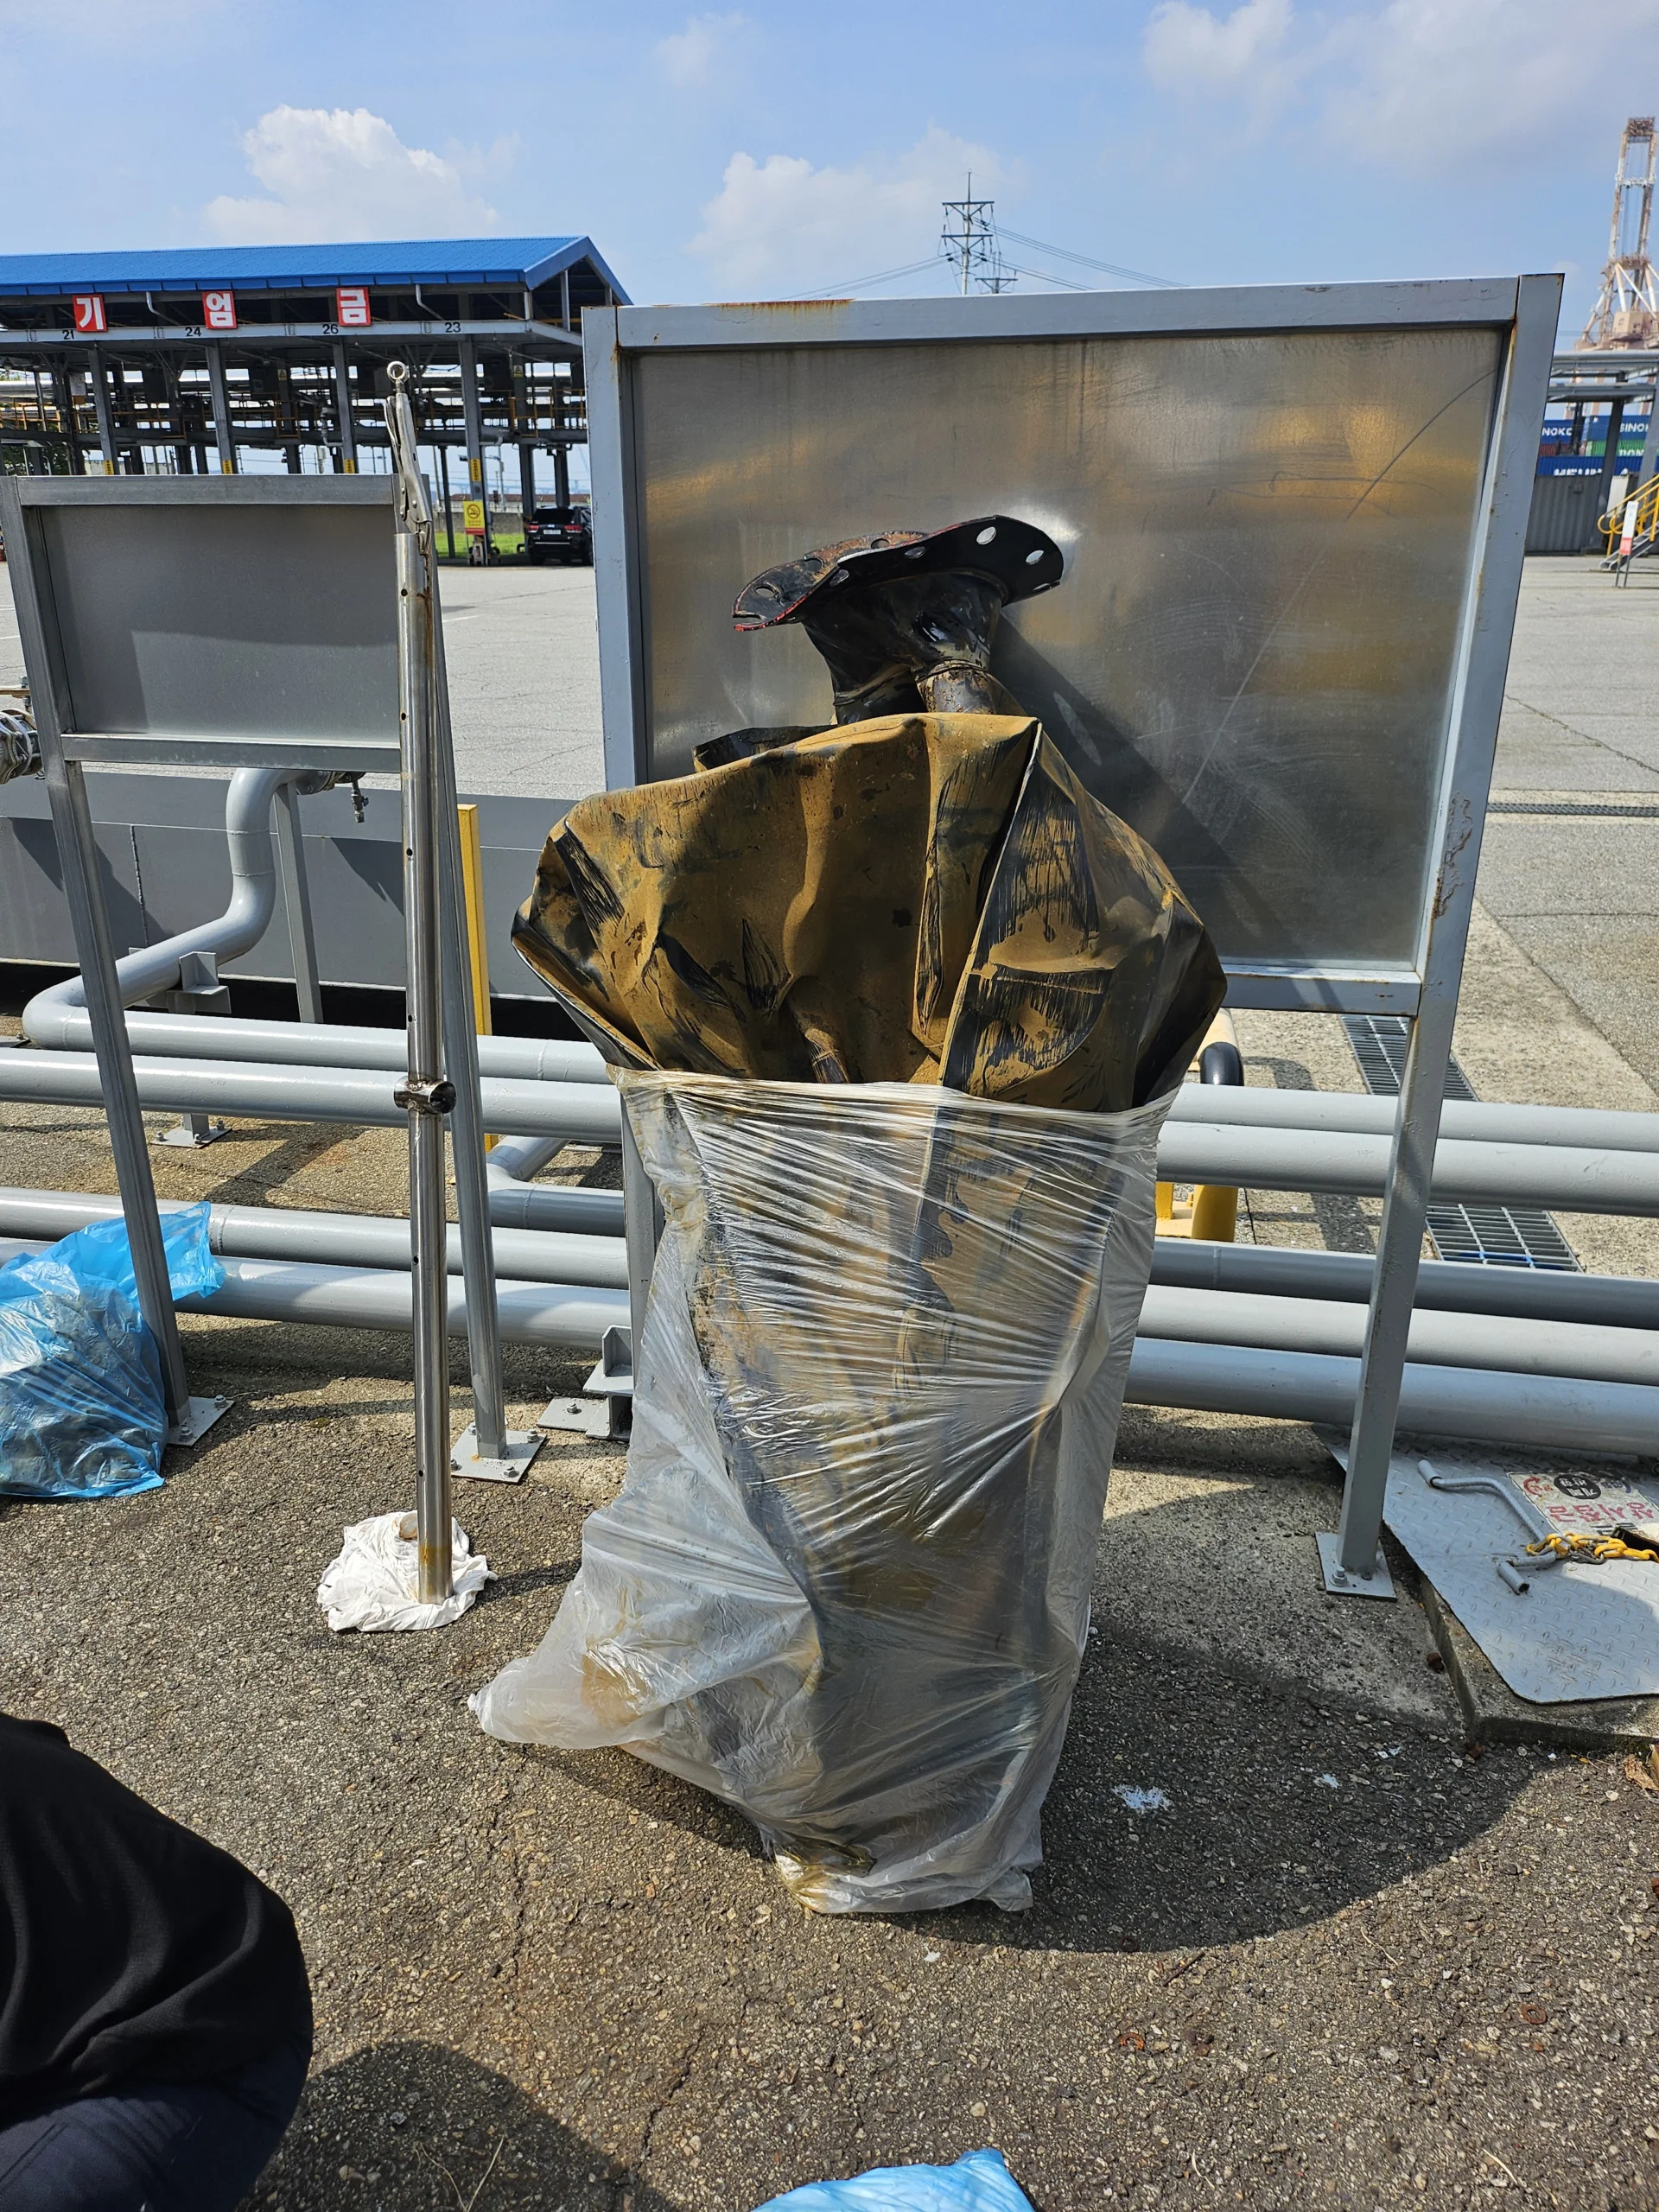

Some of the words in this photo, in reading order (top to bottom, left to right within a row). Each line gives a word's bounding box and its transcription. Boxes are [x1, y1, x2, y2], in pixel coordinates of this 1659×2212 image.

[76, 296, 105, 330] 기
[206, 292, 234, 327] 엄
[340, 289, 367, 324] 금
[184, 327, 202, 338] 24
[321, 323, 339, 334] 26
[444, 321, 461, 334] 23
[62, 329, 75, 340] 21
[1559, 1478, 1587, 1487] 방향
[1567, 1487, 1598, 1497] 개폐
